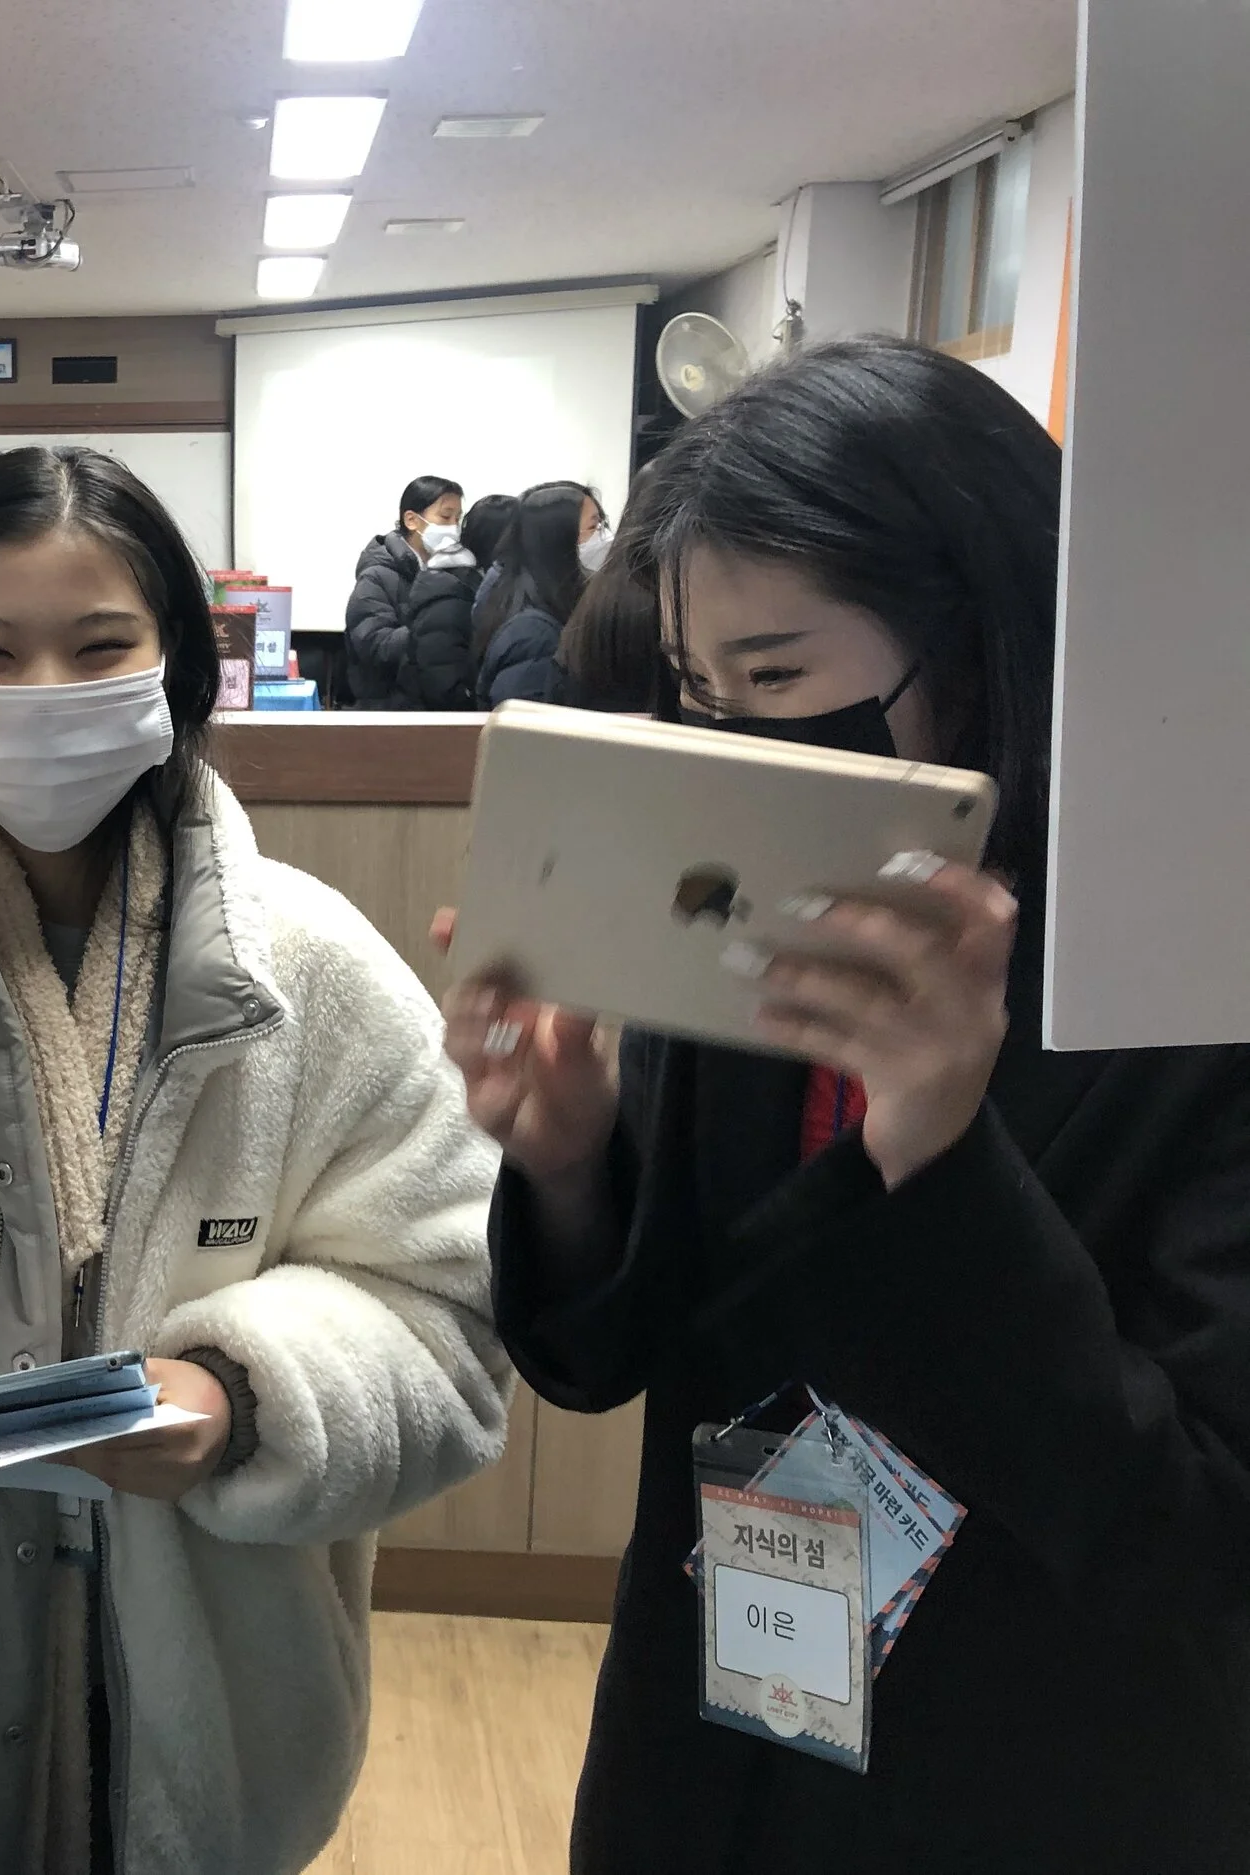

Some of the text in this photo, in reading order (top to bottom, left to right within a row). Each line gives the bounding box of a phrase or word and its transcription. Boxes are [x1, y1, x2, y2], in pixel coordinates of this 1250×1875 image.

[873, 1481, 903, 1520] 마련
[898, 1513, 929, 1552] 카드
[734, 1524, 825, 1570] 지식의 섬
[747, 1603, 796, 1641] 이은
